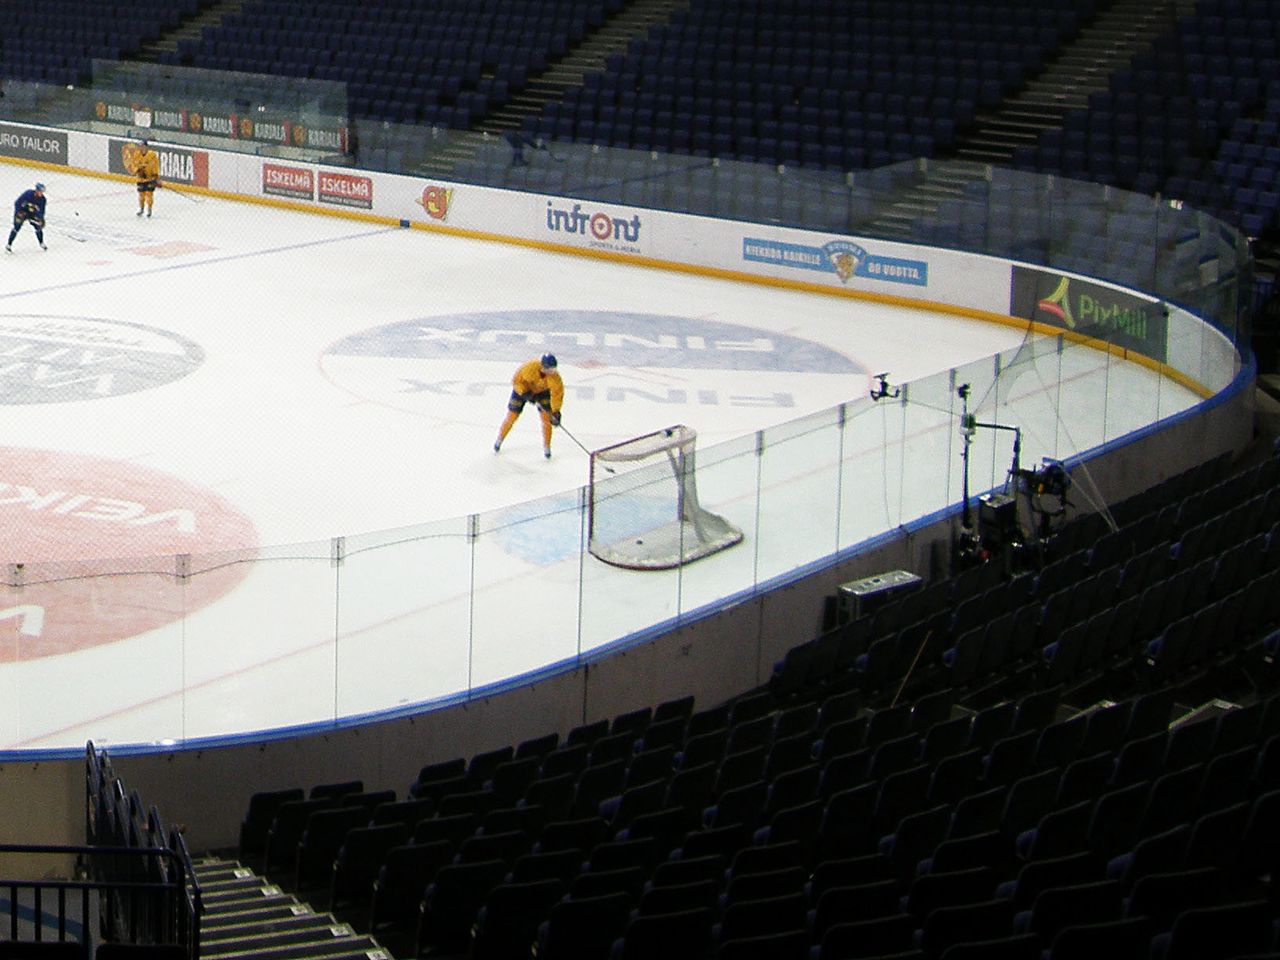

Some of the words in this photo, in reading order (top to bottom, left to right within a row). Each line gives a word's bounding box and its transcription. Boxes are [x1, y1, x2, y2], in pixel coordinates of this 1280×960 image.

[21, 136, 60, 154] TAILOR
[157, 152, 193, 179] RJALA
[267, 170, 311, 188] ISKELMÄ
[322, 177, 369, 196] ISKELMÄ
[547, 201, 641, 242] infront
[417, 327, 774, 352] FINLUX
